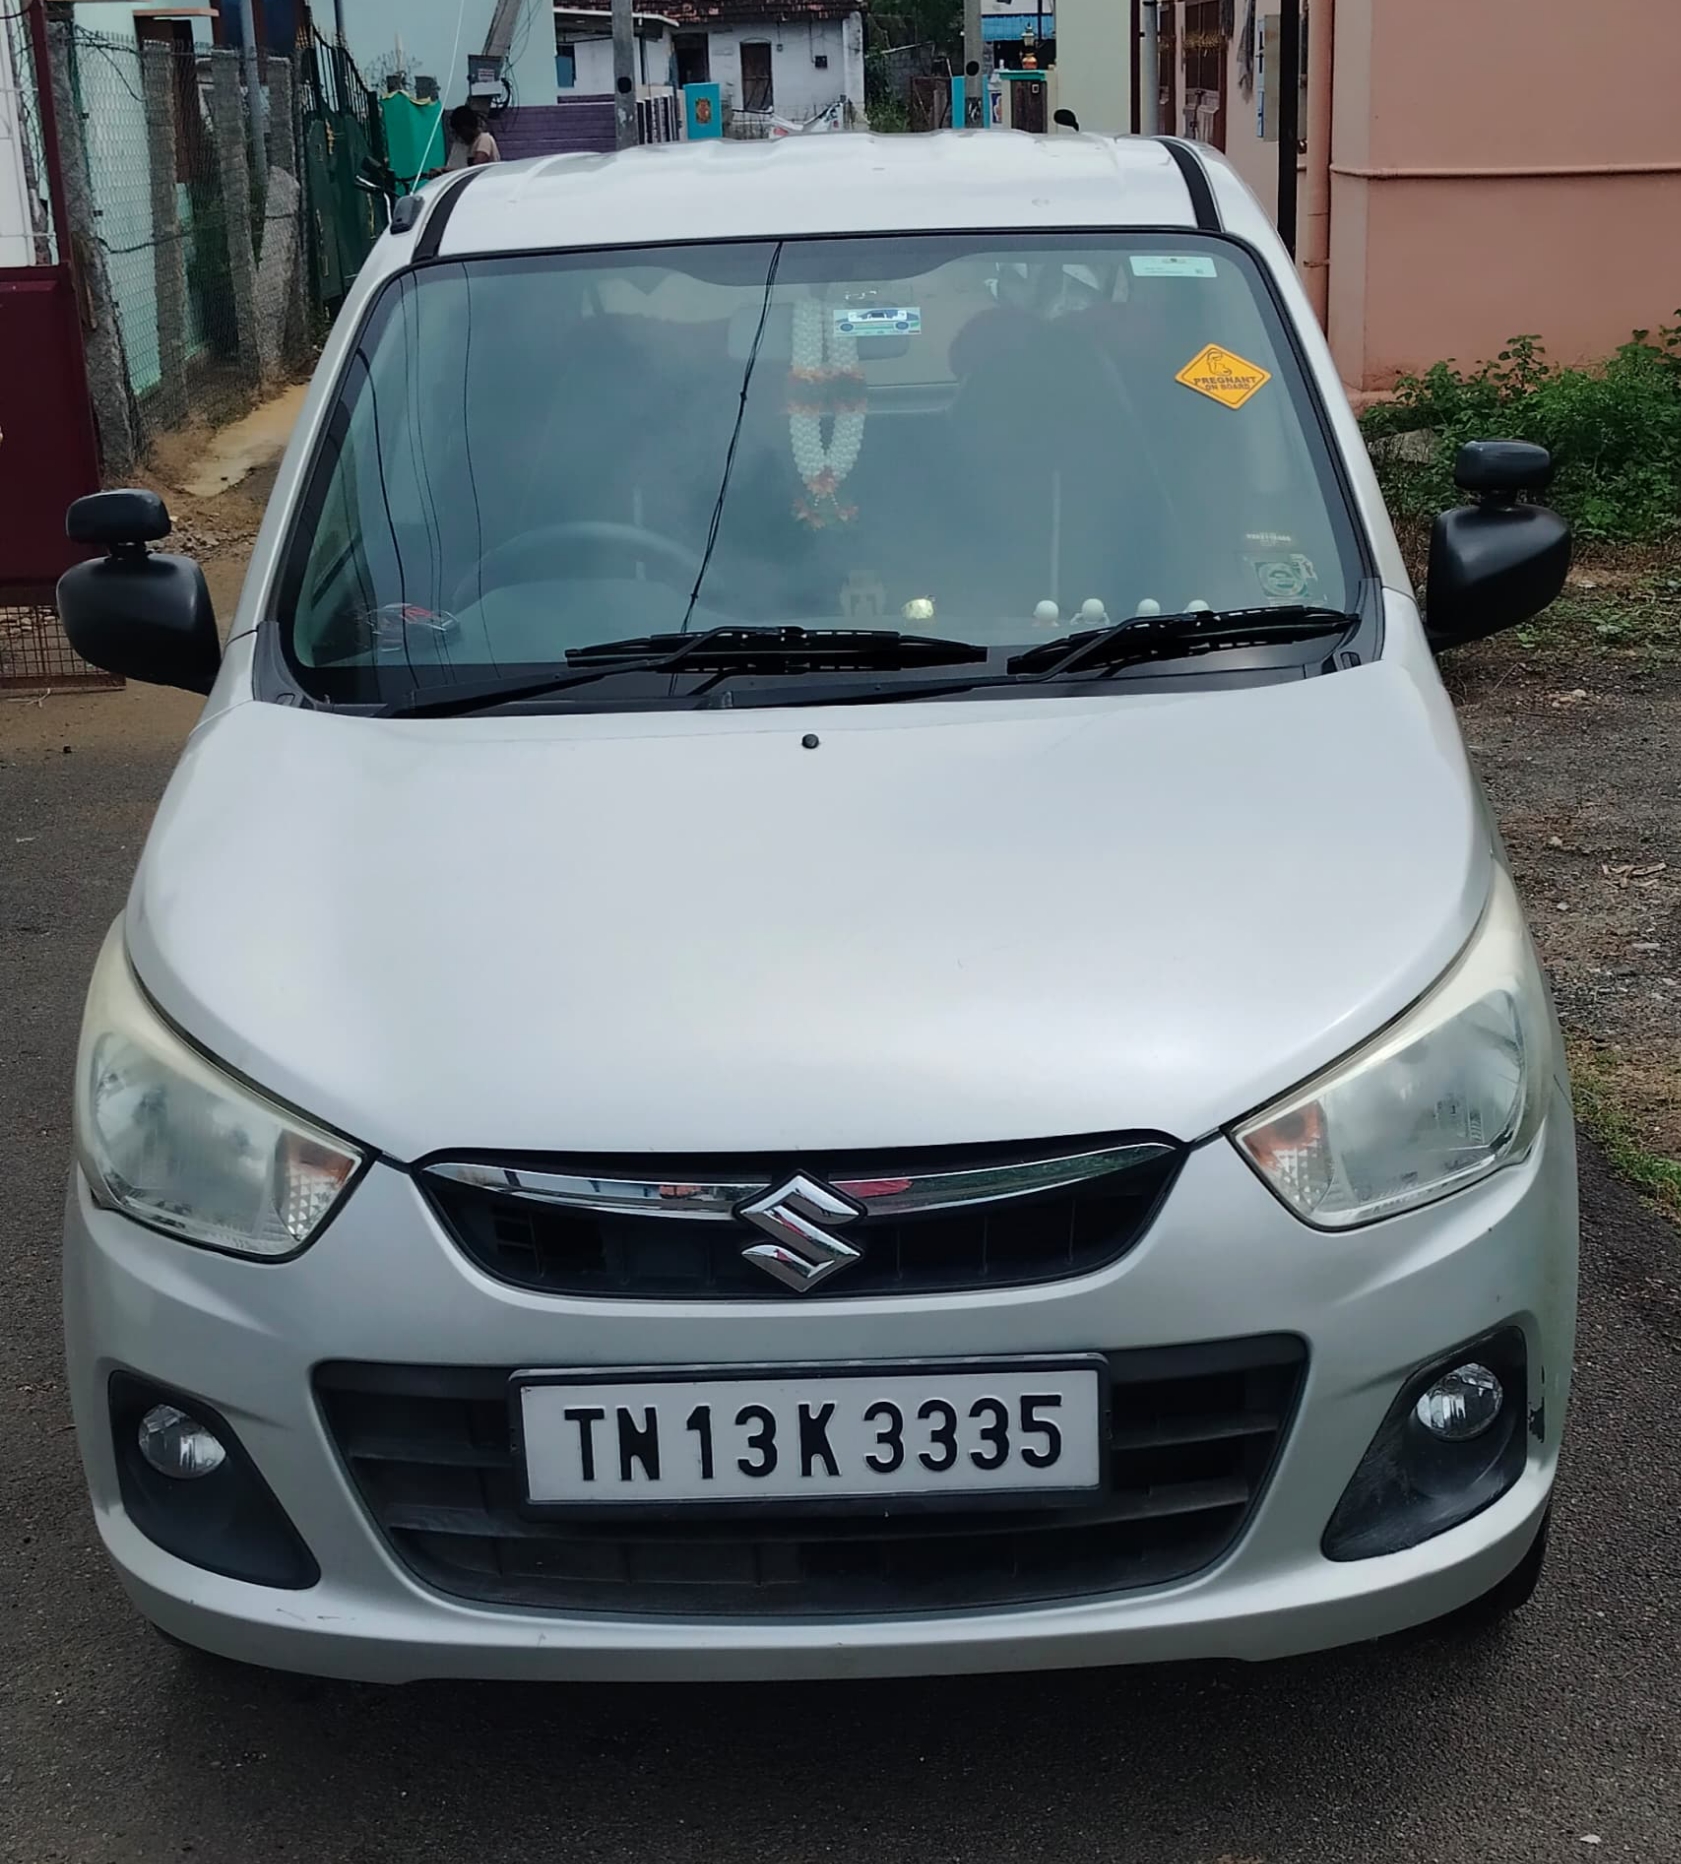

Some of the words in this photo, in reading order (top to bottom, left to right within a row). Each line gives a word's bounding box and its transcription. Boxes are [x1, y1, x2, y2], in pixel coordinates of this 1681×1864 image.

[1193, 376, 1256, 386] PREGNANT
[564, 1407, 660, 1481] TN
[686, 1404, 778, 1479] 13
[798, 1402, 841, 1477] K
[863, 1393, 1062, 1474] 3335
